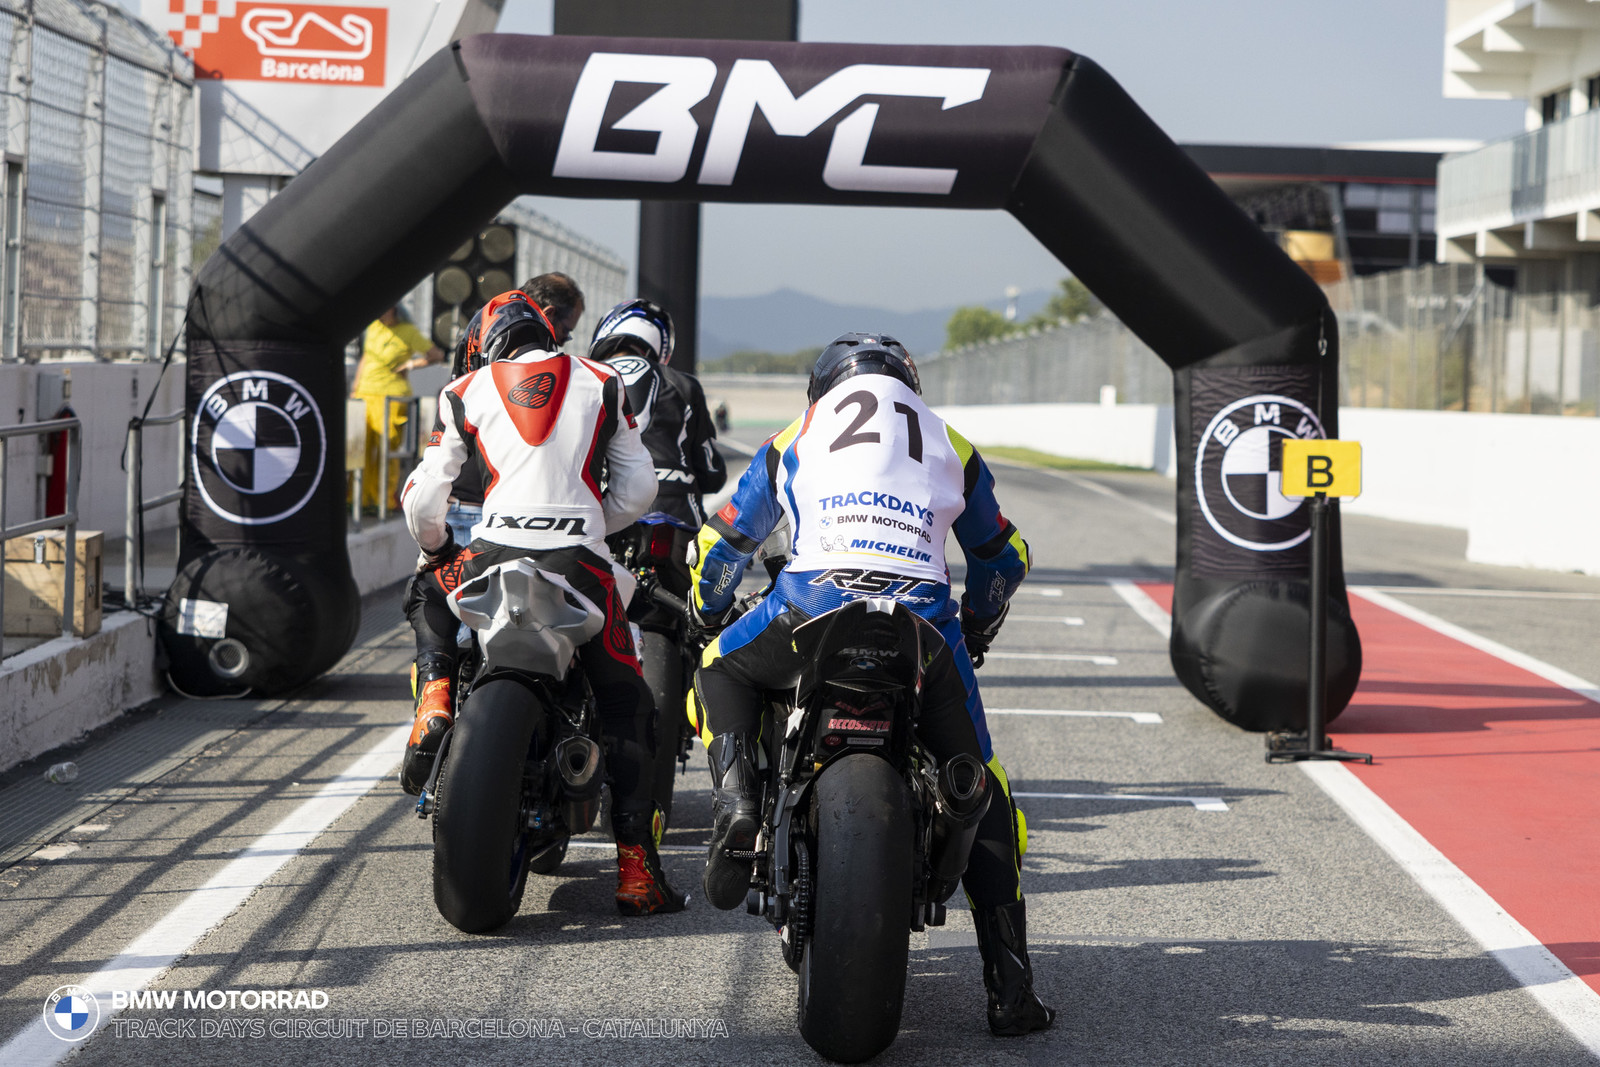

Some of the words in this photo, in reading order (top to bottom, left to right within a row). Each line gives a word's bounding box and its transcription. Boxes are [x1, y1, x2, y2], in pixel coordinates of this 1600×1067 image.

[261, 59, 364, 81] Barcelona
[552, 52, 991, 194] BMC
[206, 379, 311, 421] BMW
[829, 390, 923, 464] 21
[1213, 403, 1319, 447] BMW
[1306, 455, 1334, 488] B
[819, 490, 935, 527] TRACKDAYS
[837, 515, 868, 524] BMW
[871, 516, 932, 543] MOTORRAD
[850, 539, 932, 562] MICHELIN
[808, 568, 939, 595] RST
